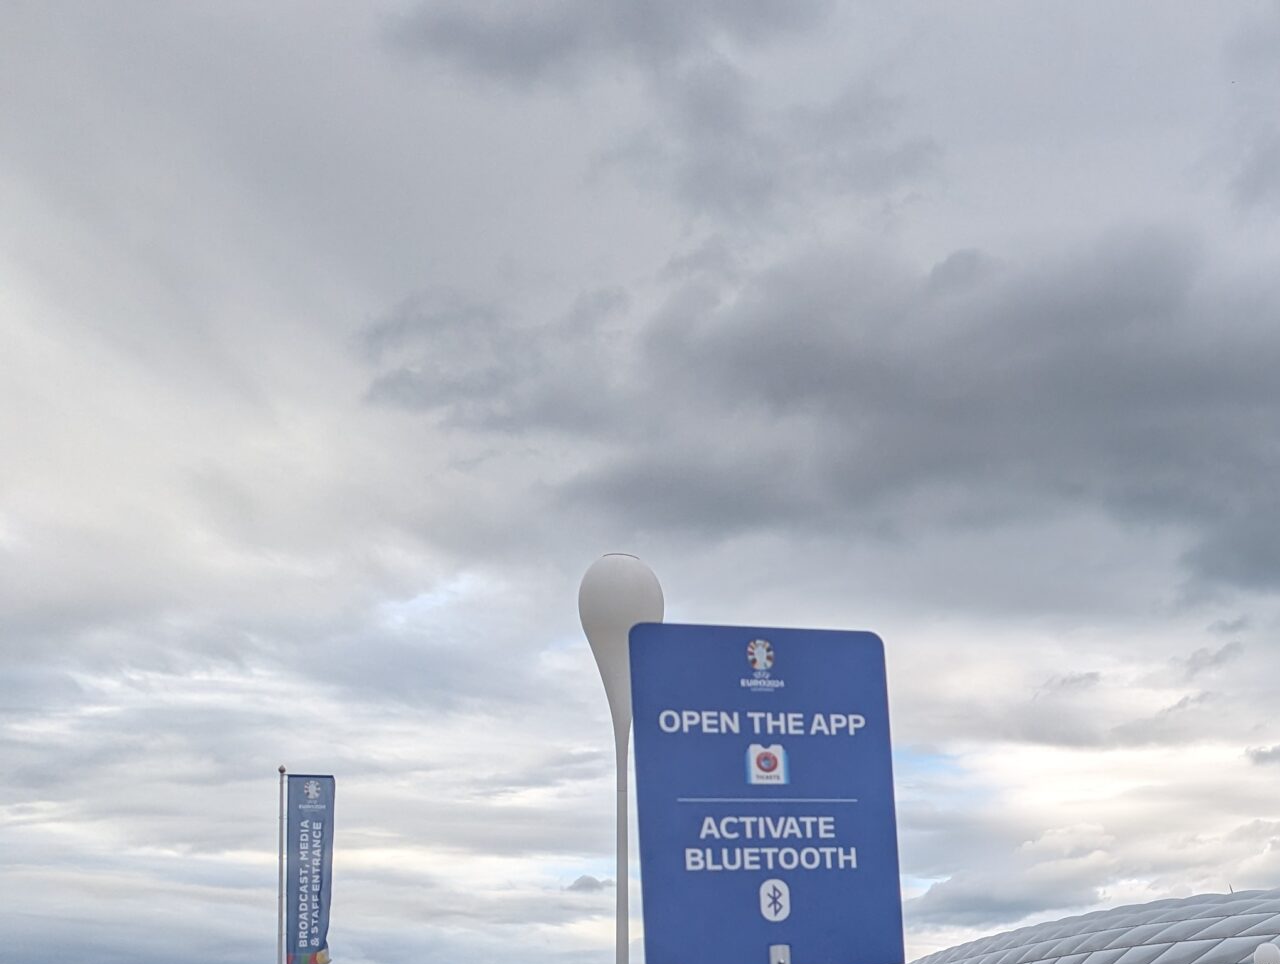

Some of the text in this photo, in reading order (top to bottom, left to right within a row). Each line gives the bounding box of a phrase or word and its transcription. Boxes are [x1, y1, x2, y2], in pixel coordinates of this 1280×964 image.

[659, 710, 866, 736] OPEN THE APP
[699, 816, 836, 839] ACTIVATE
[312, 821, 323, 892] ENTRANCE
[685, 847, 858, 871] BLUETOOTH
[298, 819, 311, 948] BROADCAST, MEDIA
[310, 893, 322, 936] STAFF
[310, 937, 321, 947] &
